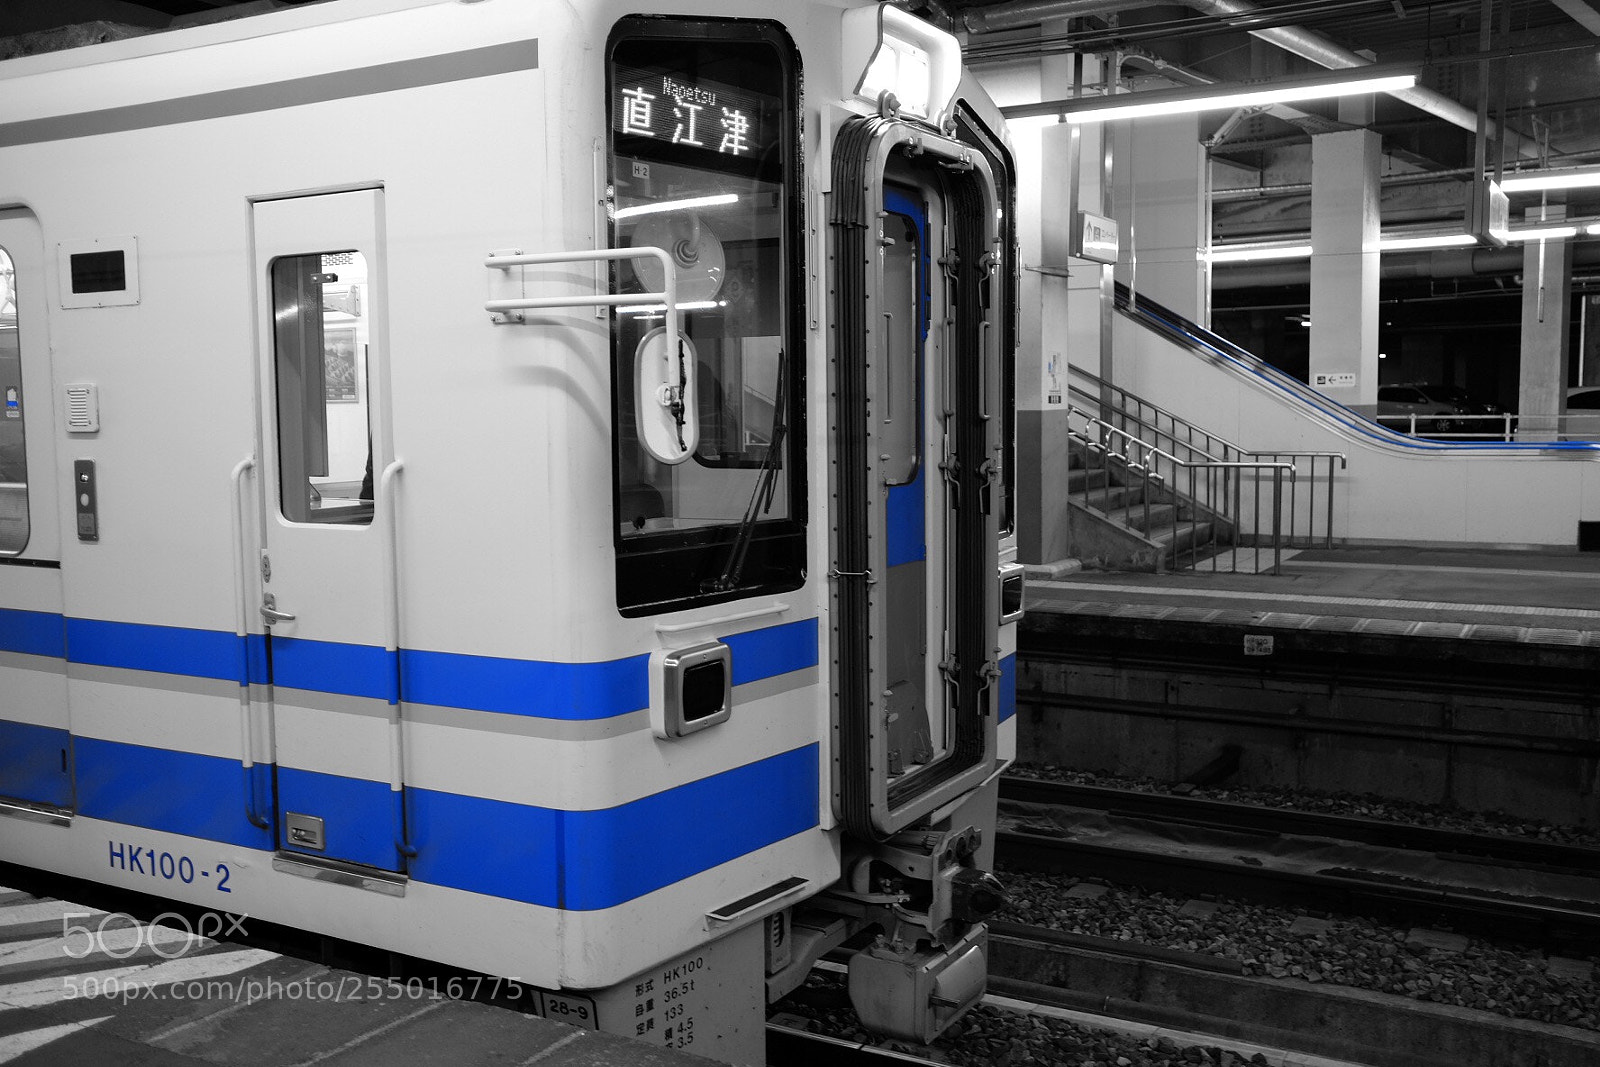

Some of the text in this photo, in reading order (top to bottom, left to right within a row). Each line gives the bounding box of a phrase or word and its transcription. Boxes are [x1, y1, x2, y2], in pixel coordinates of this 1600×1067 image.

[663, 76, 716, 106] Naoetsu
[622, 87, 750, 155] 直江津
[634, 165, 648, 177] H-2
[109, 841, 232, 893] HK100-2
[635, 957, 704, 998] 形式 HK100
[550, 999, 588, 1020] 28-9
[635, 998, 655, 1018] 自重
[664, 1003, 684, 1022] 133
[677, 1017, 694, 1035] 4.5
[677, 1031, 694, 1049] 3.5
